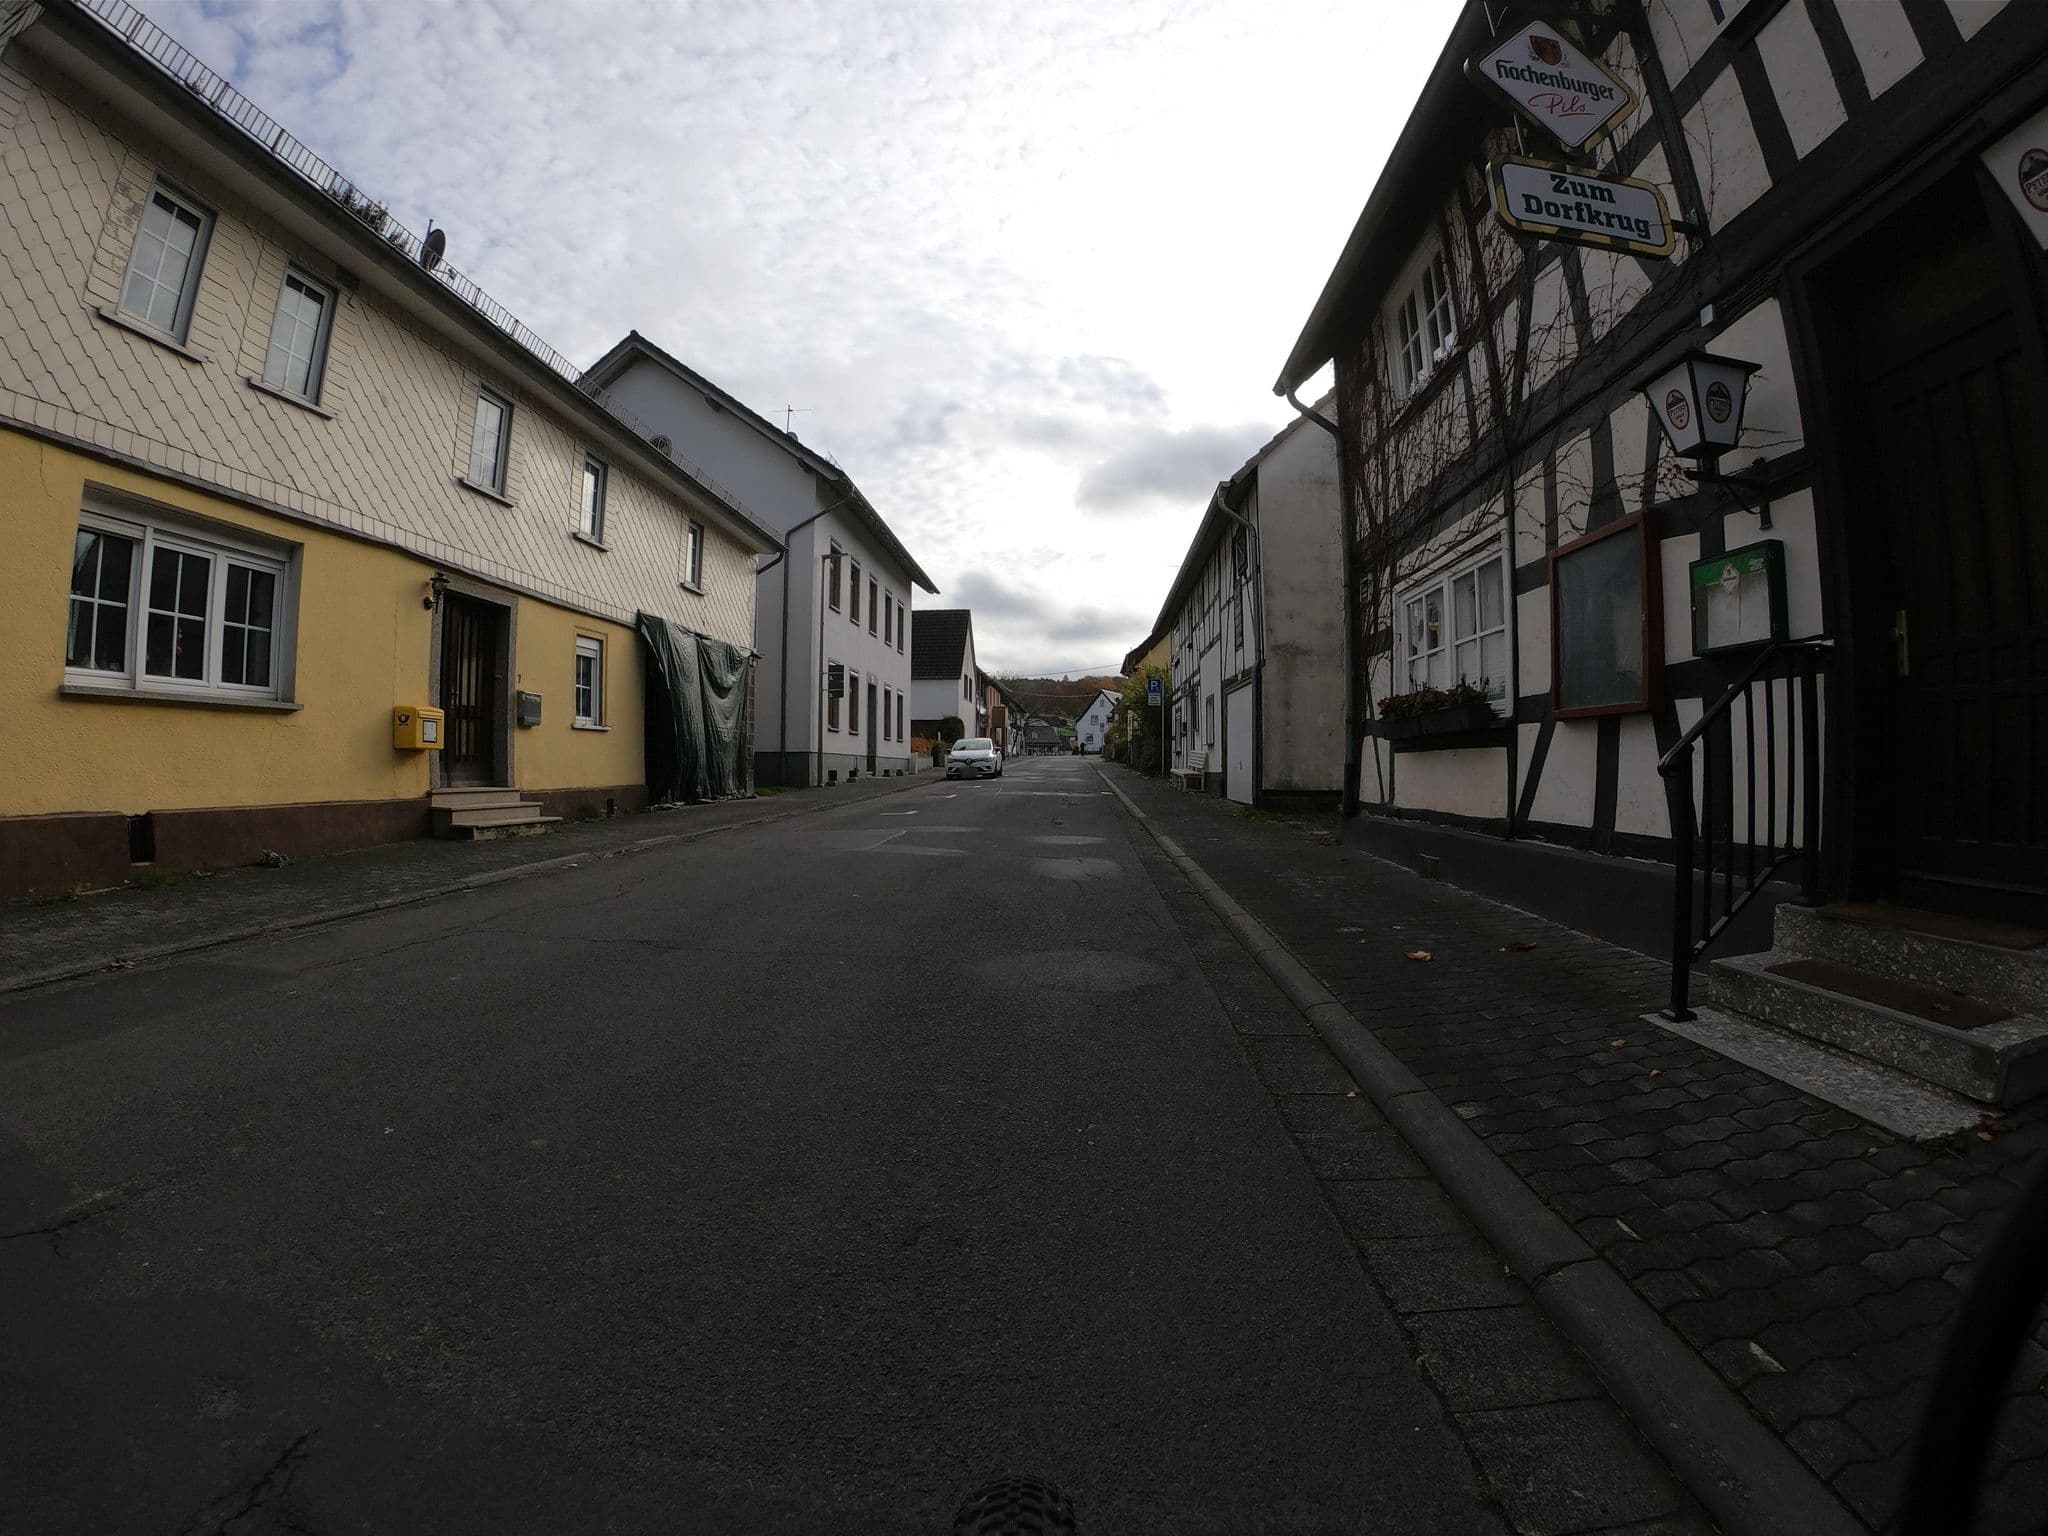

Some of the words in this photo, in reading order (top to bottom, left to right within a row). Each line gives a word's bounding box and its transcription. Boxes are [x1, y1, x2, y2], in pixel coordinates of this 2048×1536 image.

[1528, 93, 1587, 115] Pils
[1550, 174, 1617, 204] Zum
[1521, 193, 1651, 240] Dorfkrug
[1150, 680, 1158, 691] P
